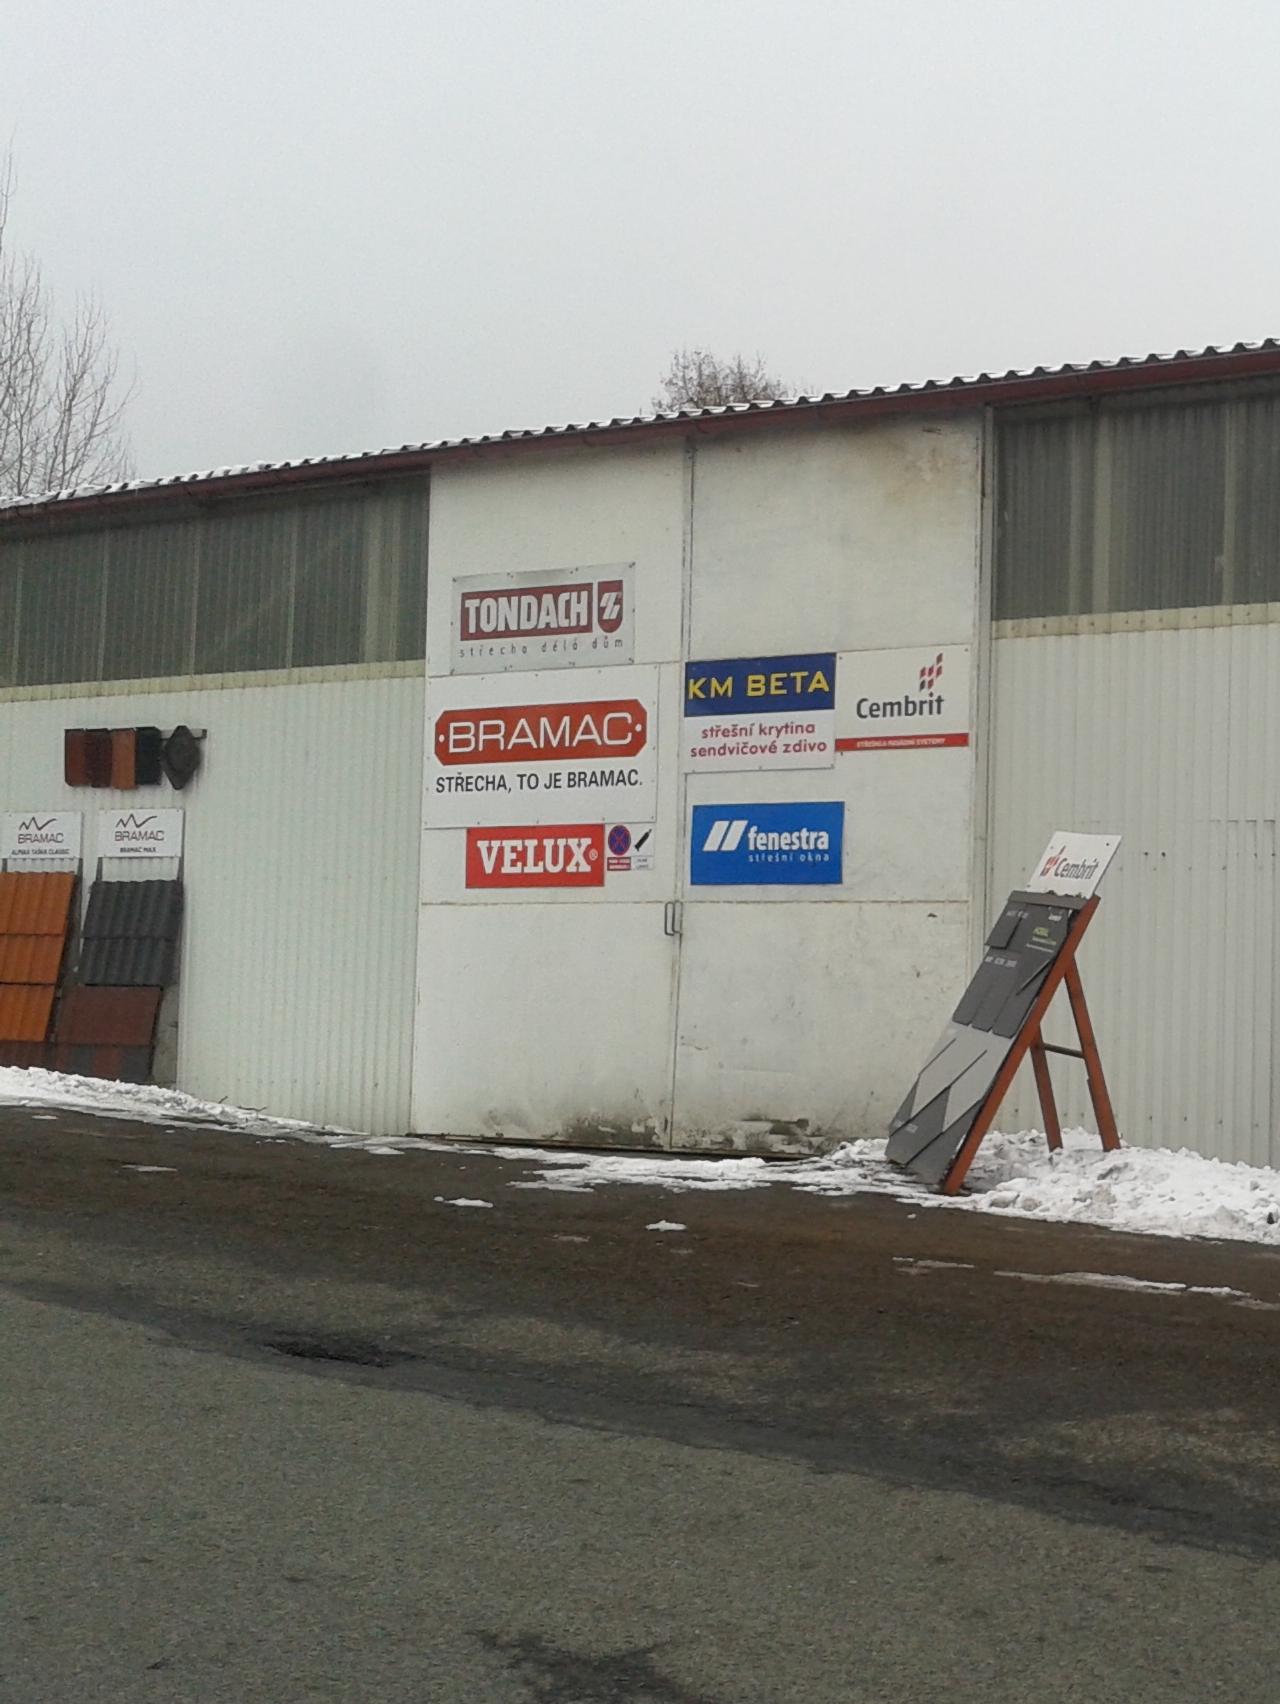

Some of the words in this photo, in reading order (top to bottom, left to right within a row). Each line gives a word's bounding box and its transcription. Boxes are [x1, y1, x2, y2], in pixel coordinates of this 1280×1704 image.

[465, 591, 588, 633] TONDACH
[688, 676, 733, 700] KM
[746, 671, 830, 697] BETA
[856, 693, 945, 719] Cembrit
[448, 712, 632, 753] BRAMAC
[702, 722, 755, 739] střešní
[759, 721, 815, 739] krytina
[690, 741, 777, 758] sendvičové
[782, 740, 827, 754] zdivo
[436, 772, 512, 793] STŘECHA,
[517, 773, 539, 790] TO
[545, 773, 563, 789] JE
[567, 769, 642, 788] BRAMAC.
[18, 833, 64, 844] BRAMAC
[115, 830, 165, 841] BRAMAC
[748, 826, 829, 851] fenestra
[477, 837, 593, 874] VELUX
[748, 852, 793, 862] střešní
[800, 851, 830, 862] okna
[1054, 857, 1099, 880] Cembrit
